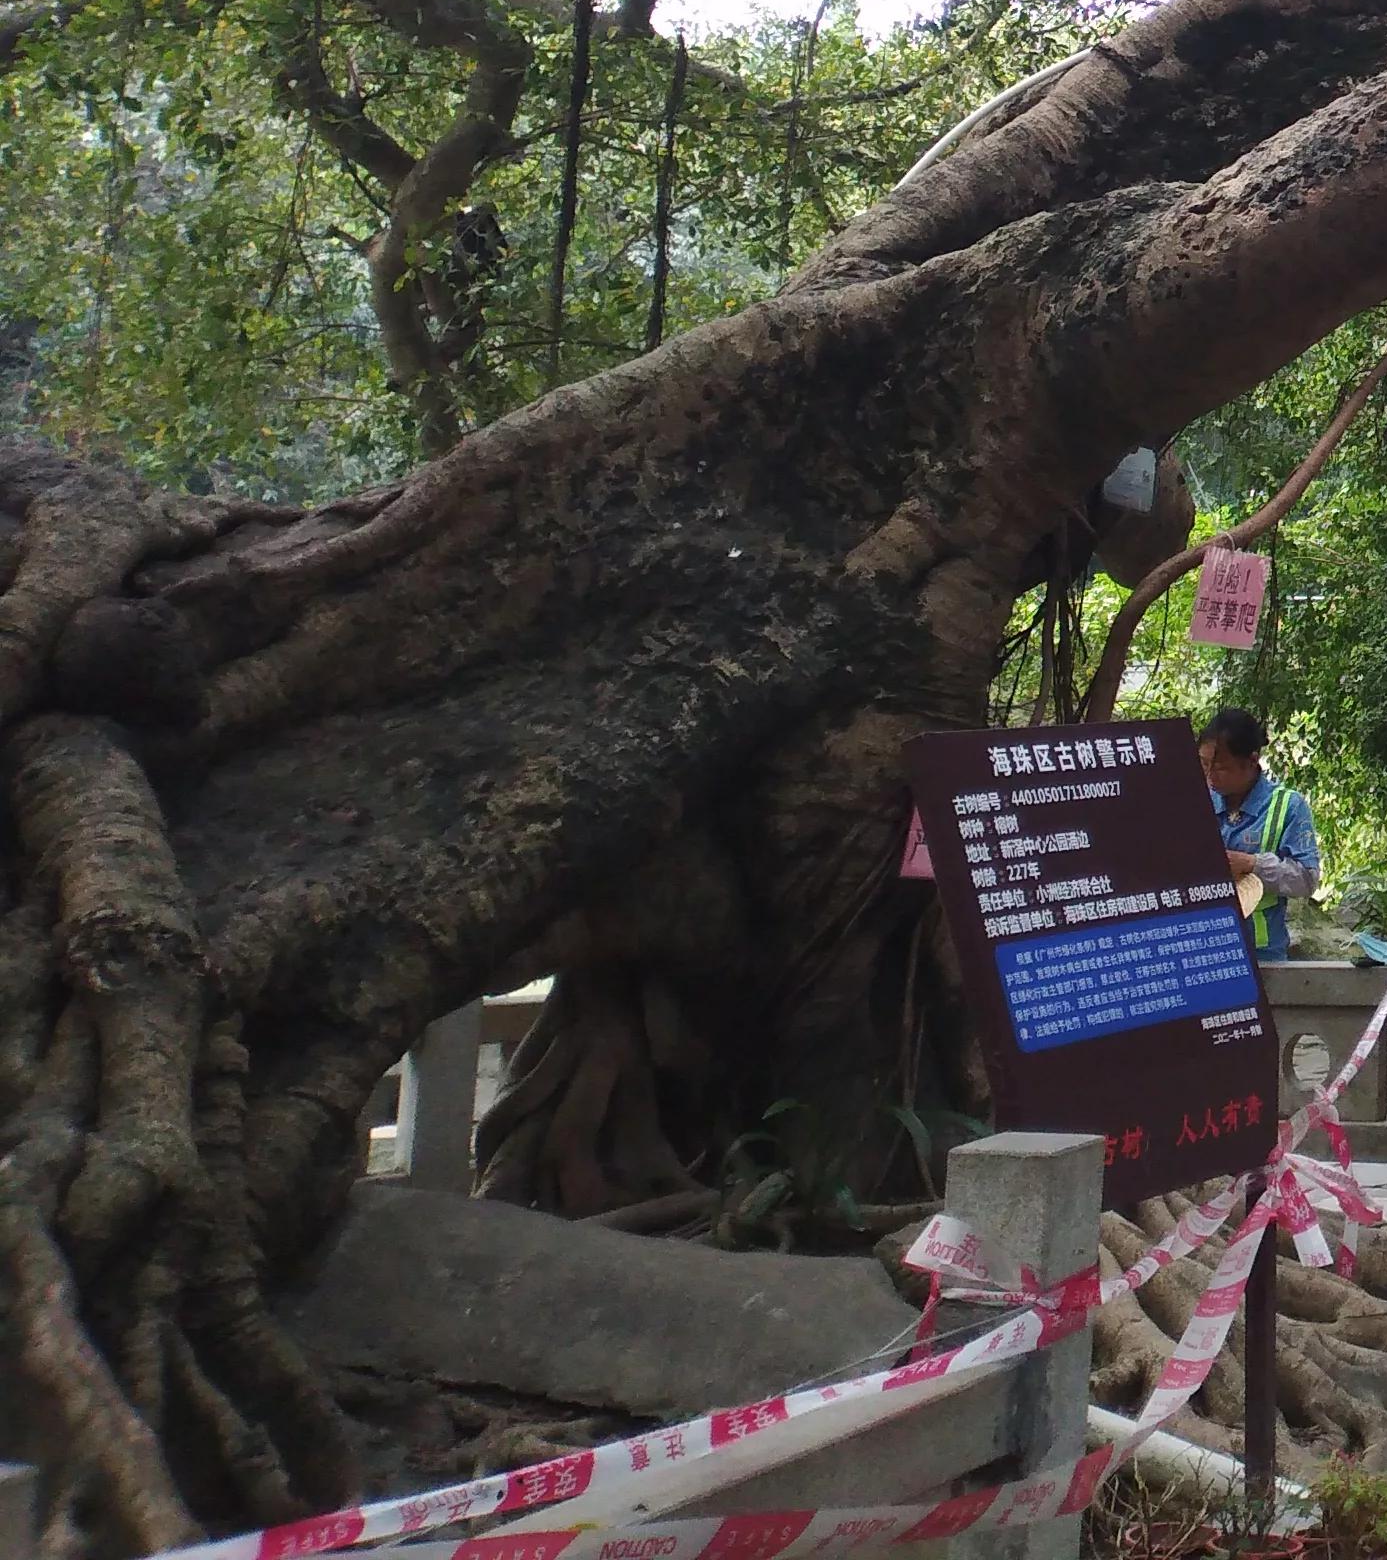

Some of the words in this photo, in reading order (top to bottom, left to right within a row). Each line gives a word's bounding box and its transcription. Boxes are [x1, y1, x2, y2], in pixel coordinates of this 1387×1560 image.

[987, 735, 1156, 777] 海珠区古树警示牌
[958, 814, 1019, 840] 树种：榕树
[971, 861, 1042, 888] 树龄：227年
[977, 875, 1114, 914] 责任单位：小洲经济联合社
[1160, 881, 1236, 908] 电话：89885684
[1175, 1091, 1264, 1147] 人人有责
[629, 1430, 688, 1472] 注意
[521, 1463, 579, 1505] 安全
[600, 1533, 679, 1558] CAUTION
